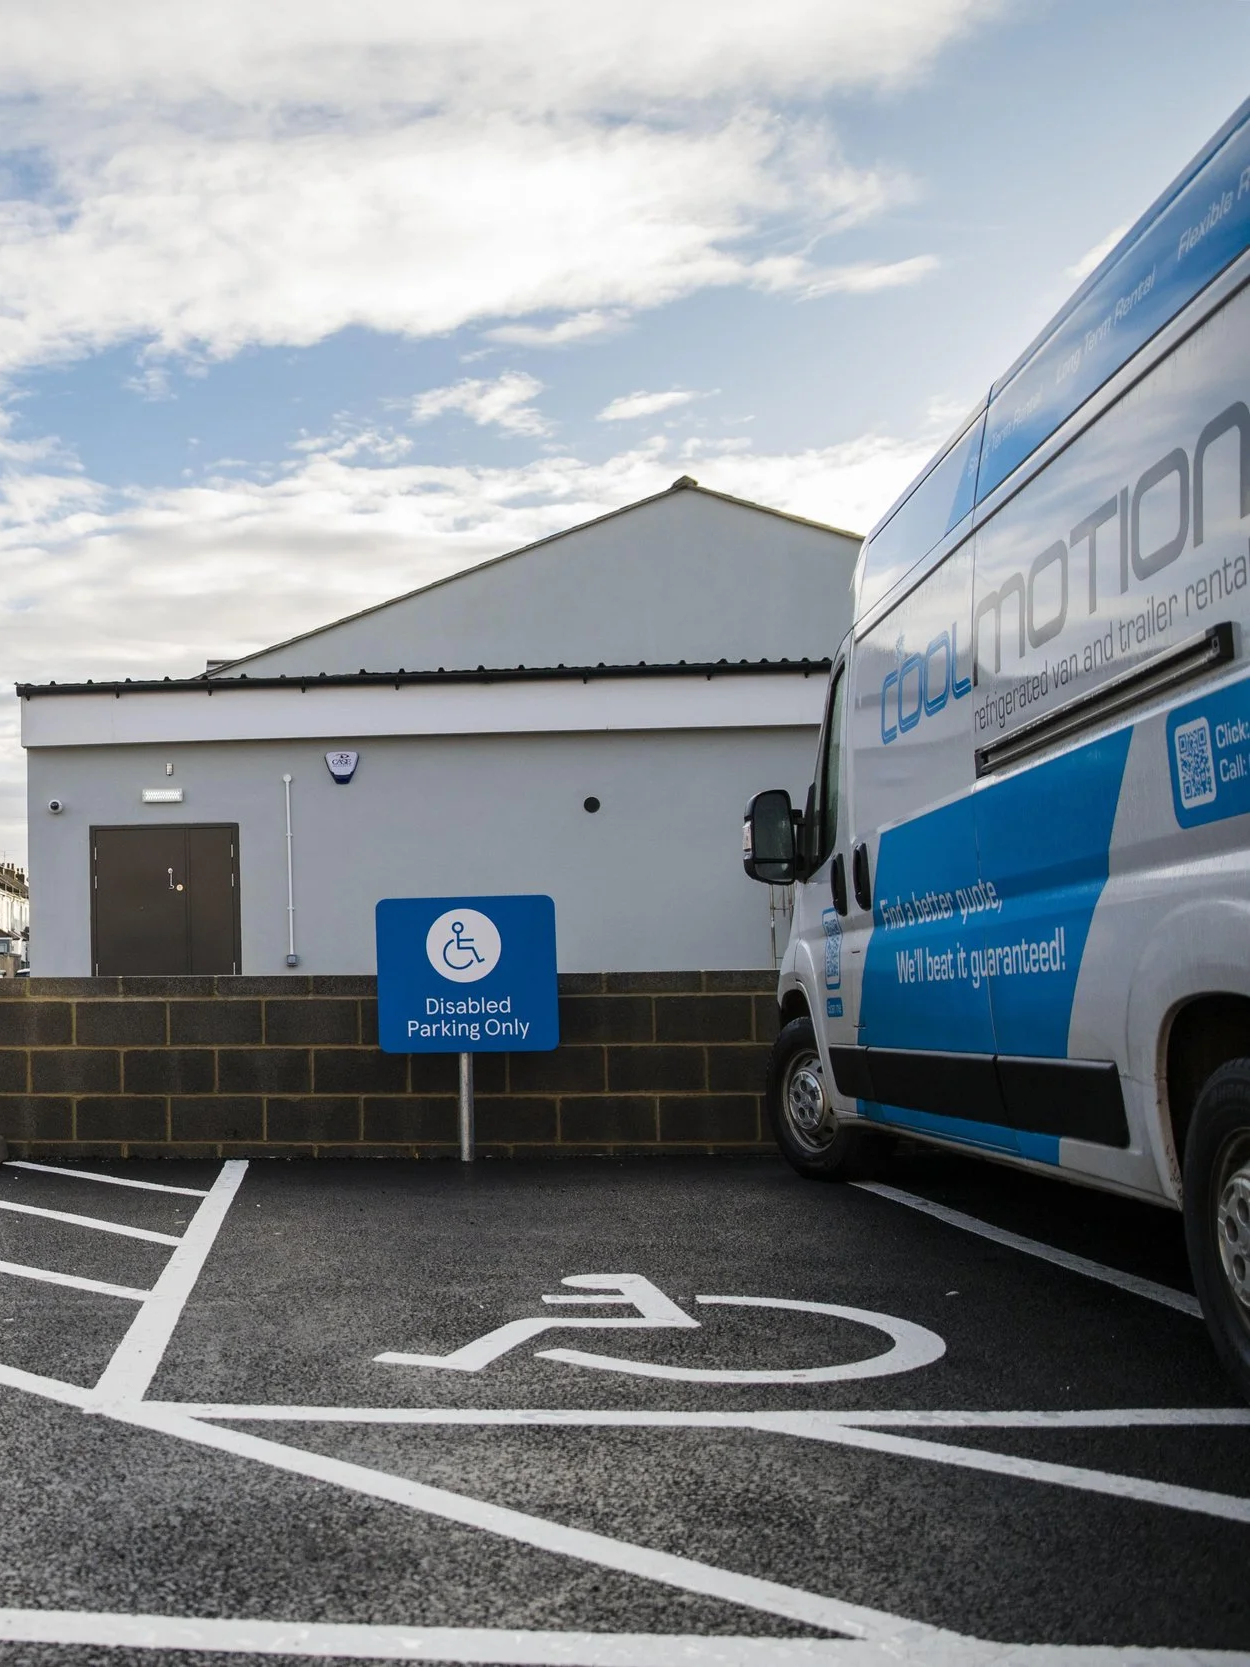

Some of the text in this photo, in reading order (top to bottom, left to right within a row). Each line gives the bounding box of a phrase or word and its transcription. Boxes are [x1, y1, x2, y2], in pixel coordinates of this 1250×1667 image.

[1177, 191, 1234, 261] Flexible
[1084, 316, 1111, 355] Term
[1114, 263, 1156, 326] Rental
[974, 667, 1049, 733] refrigerated
[1052, 654, 1078, 688] van
[1084, 622, 1113, 663] and
[1118, 594, 1178, 653] trailer
[1215, 718, 1250, 749] Click:
[1219, 753, 1248, 782] Call:
[879, 878, 1003, 931] Find a better quote,
[896, 926, 1066, 989] We'll beat it guaranteed!
[407, 1018, 530, 1040] Parking Only
[426, 996, 511, 1015] Disabled
